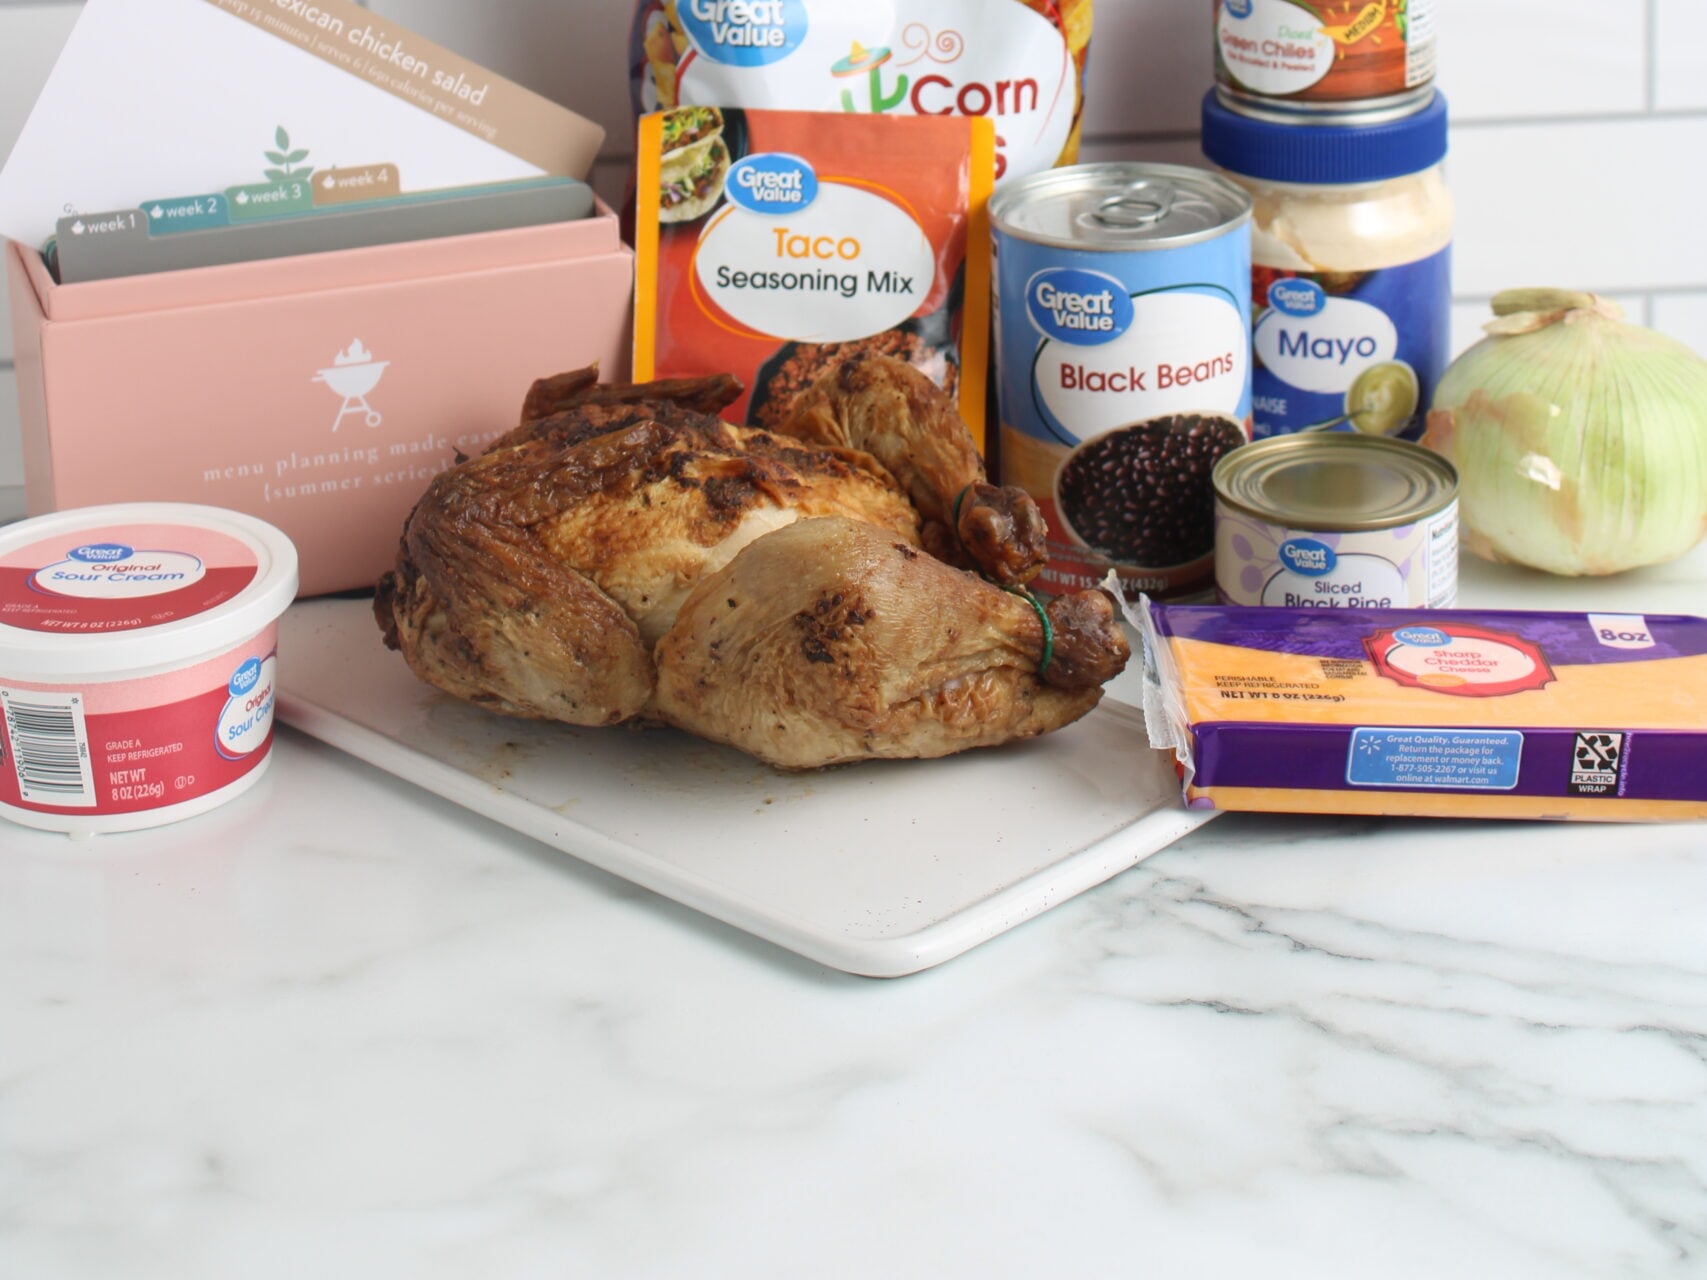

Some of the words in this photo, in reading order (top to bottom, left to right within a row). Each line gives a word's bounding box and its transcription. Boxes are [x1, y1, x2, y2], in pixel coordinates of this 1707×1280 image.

[710, 23, 786, 47] Value
[1262, 40, 1315, 60] Chiles
[347, 23, 429, 79] chicken
[431, 71, 490, 107] salad
[263, 14, 311, 44] minutes
[317, 39, 353, 65] serves
[390, 79, 434, 105] calories
[433, 100, 456, 116] per
[457, 111, 498, 140] serving
[910, 74, 1038, 117] Corn
[339, 171, 373, 188] week
[377, 168, 388, 183] 4
[737, 166, 803, 190] Great
[251, 186, 288, 204] week
[292, 183, 302, 200] 3
[752, 186, 803, 202] Value
[166, 200, 204, 218] week
[207, 197, 218, 214] 2
[88, 215, 126, 234] week
[130, 214, 136, 229] 1
[772, 227, 861, 260] Taco
[716, 265, 858, 298] Seasoning
[867, 270, 914, 295] Mix
[1036, 282, 1114, 315] Great
[1274, 286, 1316, 303] Great
[1284, 299, 1316, 311] Value
[1052, 310, 1114, 331] Value
[1278, 329, 1377, 365] Mayo
[1060, 362, 1147, 393] Black
[1157, 352, 1234, 390] Beans
[203, 463, 264, 482] menu
[276, 446, 379, 477] planning
[389, 432, 447, 456] made
[78, 547, 124, 557] Great
[86, 553, 121, 561] Value
[1284, 545, 1327, 562] Great
[91, 563, 162, 573] Original
[1294, 558, 1327, 570] Value
[51, 571, 100, 581] Sour
[107, 571, 185, 582] Cream
[1060, 573, 1077, 587] WT
[1314, 581, 1362, 595] Sliced
[1284, 592, 1341, 608] Black
[63, 621, 80, 629] WT
[90, 621, 104, 629] OZ
[105, 617, 142, 628] (226g)
[1401, 631, 1441, 641] Great
[1424, 657, 1499, 668] Cheddar
[1433, 649, 1482, 660] Sharp
[233, 663, 257, 687] Great
[1438, 665, 1491, 674] Cheese
[1214, 675, 1276, 683] PERISHABLE
[1244, 682, 1320, 690] REFRIGERATED
[245, 681, 272, 713] Original
[1220, 689, 1246, 699] NET
[1249, 690, 1269, 699] WT
[229, 717, 254, 741] Sour
[105, 740, 133, 751] GRADE
[134, 739, 141, 748] A
[1387, 735, 1413, 743] Great
[1414, 736, 1450, 745] Quality.
[1452, 736, 1509, 745] Guaranteed.
[107, 752, 127, 763] KEEP
[128, 742, 183, 761] REFRIGERATED
[1399, 745, 1427, 753] Return
[1444, 746, 1479, 756] package
[1481, 746, 1493, 754] for
[1386, 755, 1439, 764] replacement
[1451, 757, 1481, 766] money
[1482, 757, 1504, 765] back.
[110, 770, 128, 785] NET
[130, 768, 146, 781] WT
[1468, 766, 1486, 775] visit
[1574, 774, 1614, 783] PLASTIC
[1396, 774, 1422, 782] online
[1434, 776, 1489, 784] walmart.com
[111, 788, 119, 800] 8
[119, 786, 133, 799] OZ
[134, 781, 165, 800] (226g)
[1578, 784, 1608, 793] WRAP
